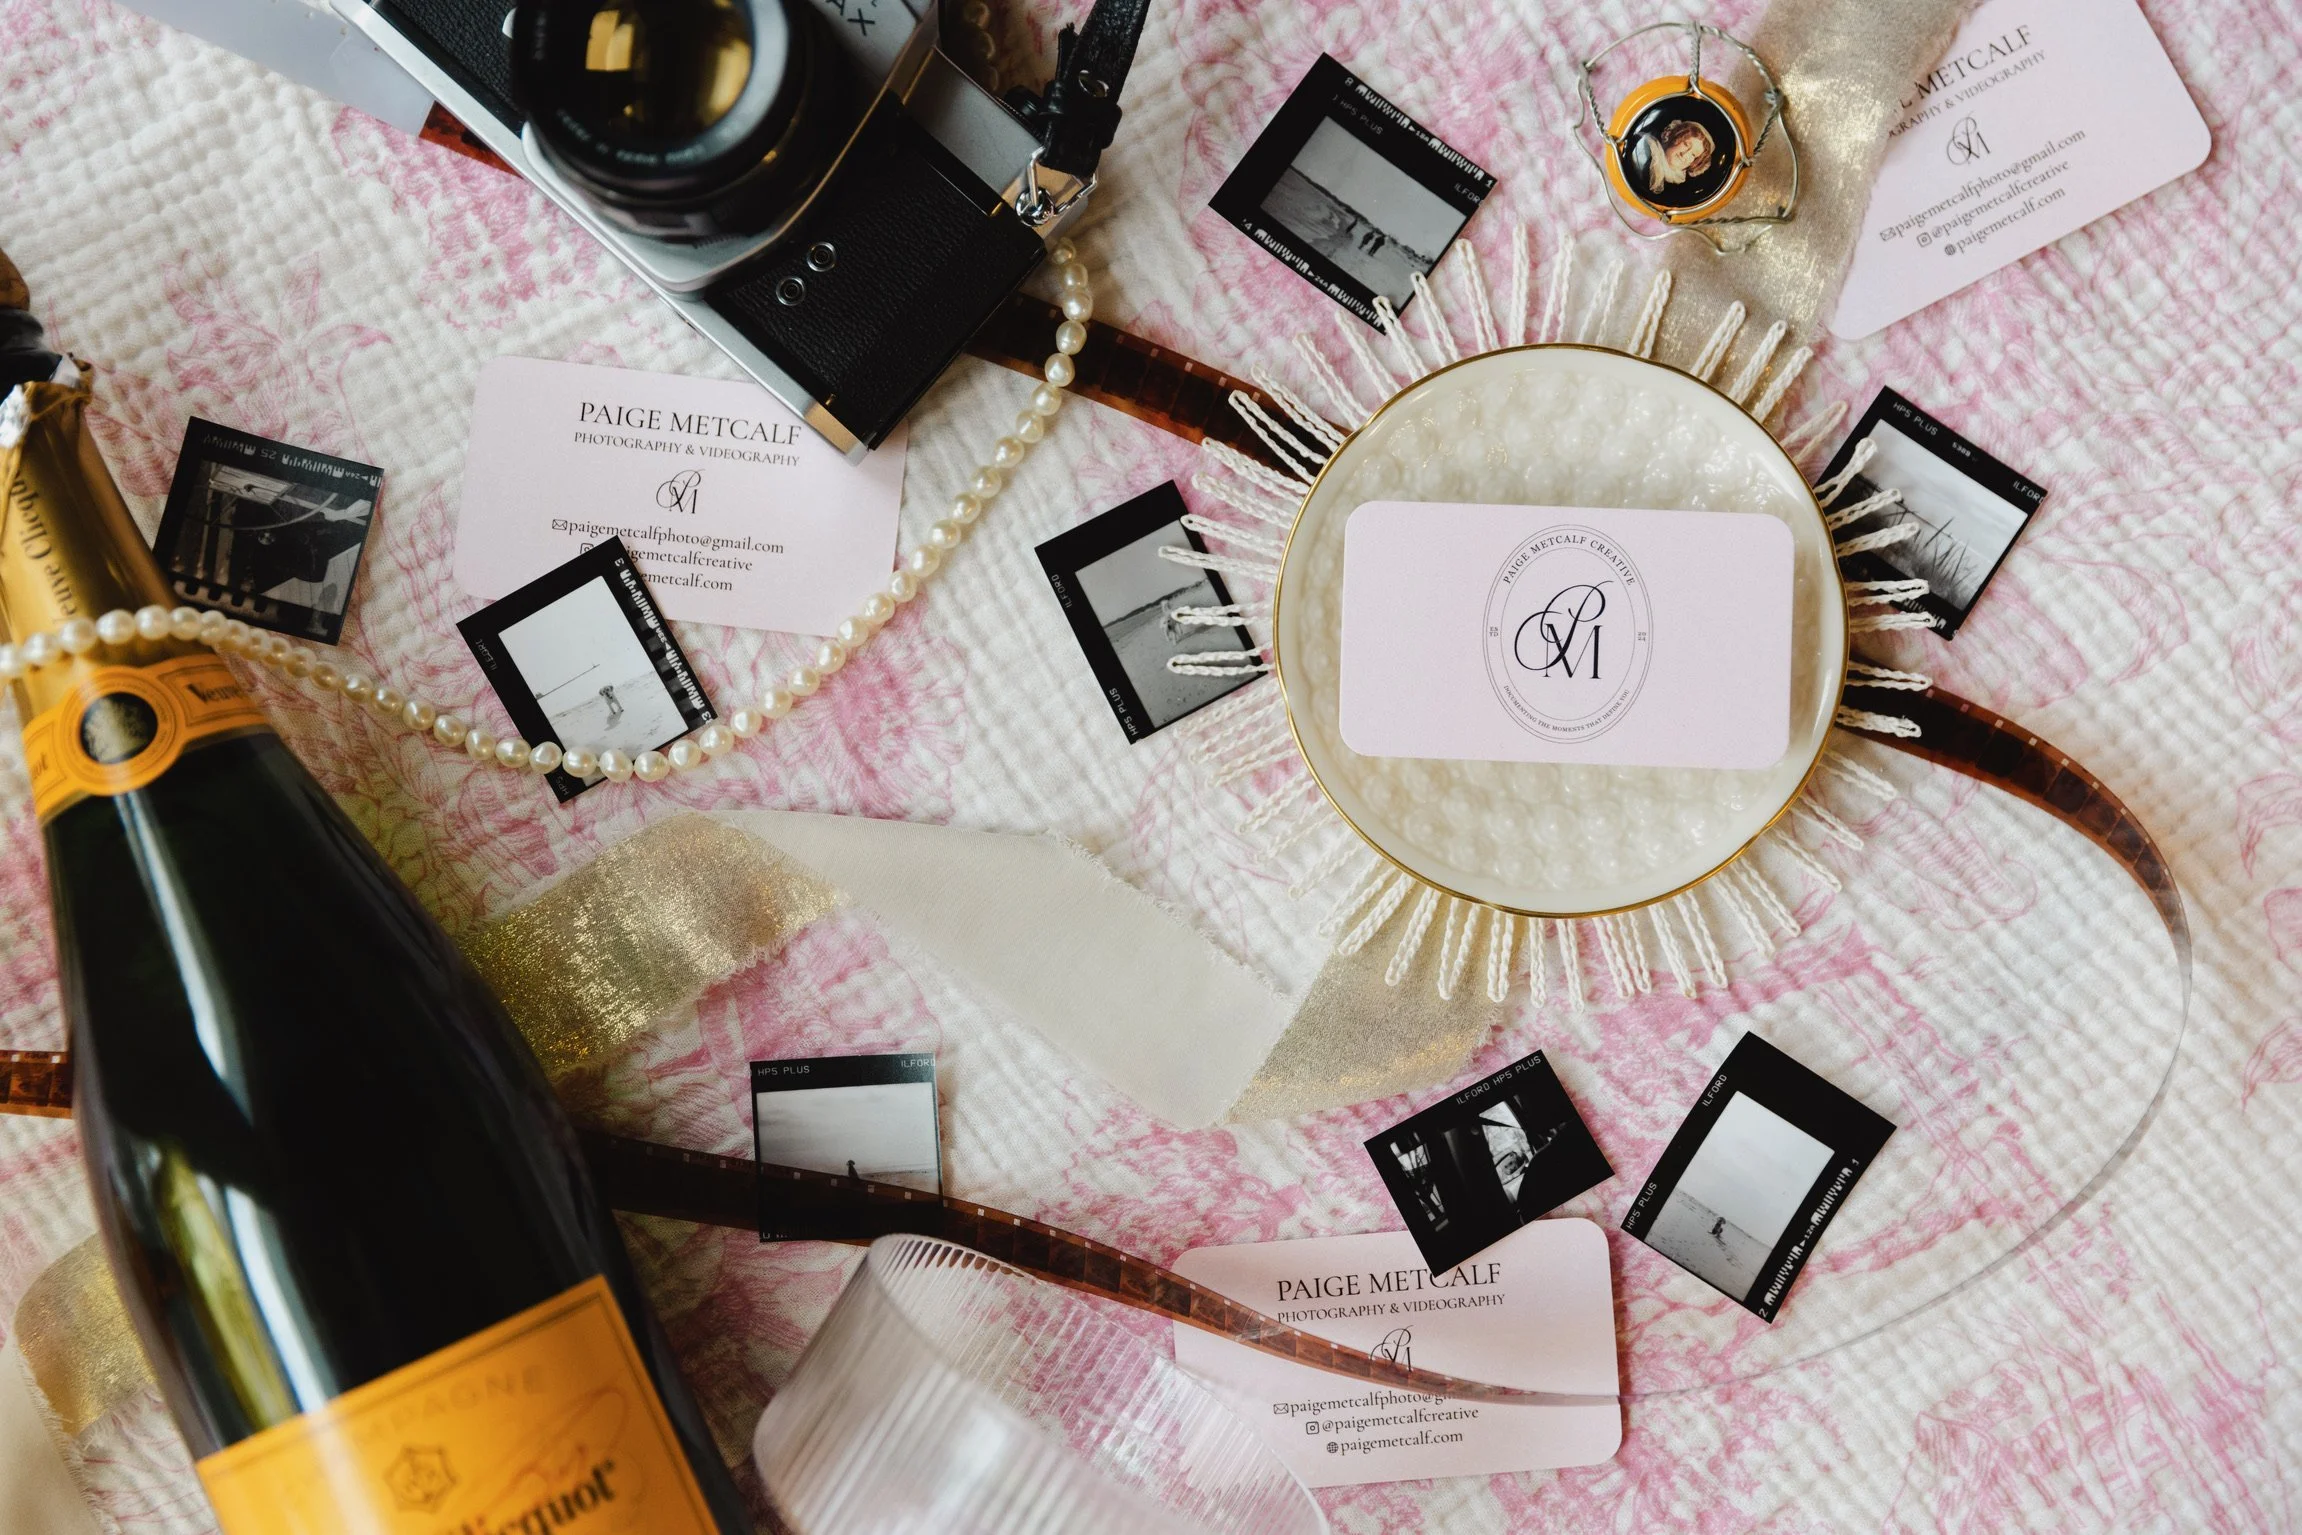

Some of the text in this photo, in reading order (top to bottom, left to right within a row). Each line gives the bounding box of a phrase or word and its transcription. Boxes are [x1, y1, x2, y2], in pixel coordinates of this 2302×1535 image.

[1914, 24, 2033, 100] METCALF
[1945, 97, 1956, 109] &
[1955, 49, 2047, 104] VIDEOGRAPHY
[1359, 114, 1384, 136] PLUS
[1895, 128, 2086, 238] paigemetcalfphoto@gmail.com
[1932, 159, 2070, 239] @paigemetcalfcreative
[1956, 185, 2067, 254] paigemetcalf.com
[579, 401, 802, 446] PAIGE METCALF
[1893, 401, 1912, 419] HP5
[1913, 414, 1939, 437] PLUS
[574, 431, 801, 467] PHOTOGRAPHY & VIDEOGRAPHY
[568, 520, 785, 555] paigemetcalfphoto@gmail.com
[626, 545, 753, 572] igemetcalfcreative
[640, 570, 734, 592] emetcalf.com
[1502, 534, 1636, 587] PAIGE METCALF CREATIVE
[44, 563, 77, 624] euve
[1051, 573, 1138, 736] HP5 PLUS ILFORD
[1503, 684, 1630, 733] DOCUMENTING THE MOMENTS THAT DEFINE YOU
[757, 1065, 810, 1077] HP5 PLUS
[1456, 1055, 1542, 1105] ILFORD HP5 PLUS
[1625, 1073, 1728, 1230] HP5 PLUS ILFORD
[1277, 1262, 1501, 1301] PAIGE METCALF
[1277, 1293, 1506, 1323] PHOTOGRAPHY & VIDEOGRAPHY
[1322, 1407, 1480, 1433] @paigemetcalfcreative
[1340, 1430, 1464, 1456] paigemetcalf.com
